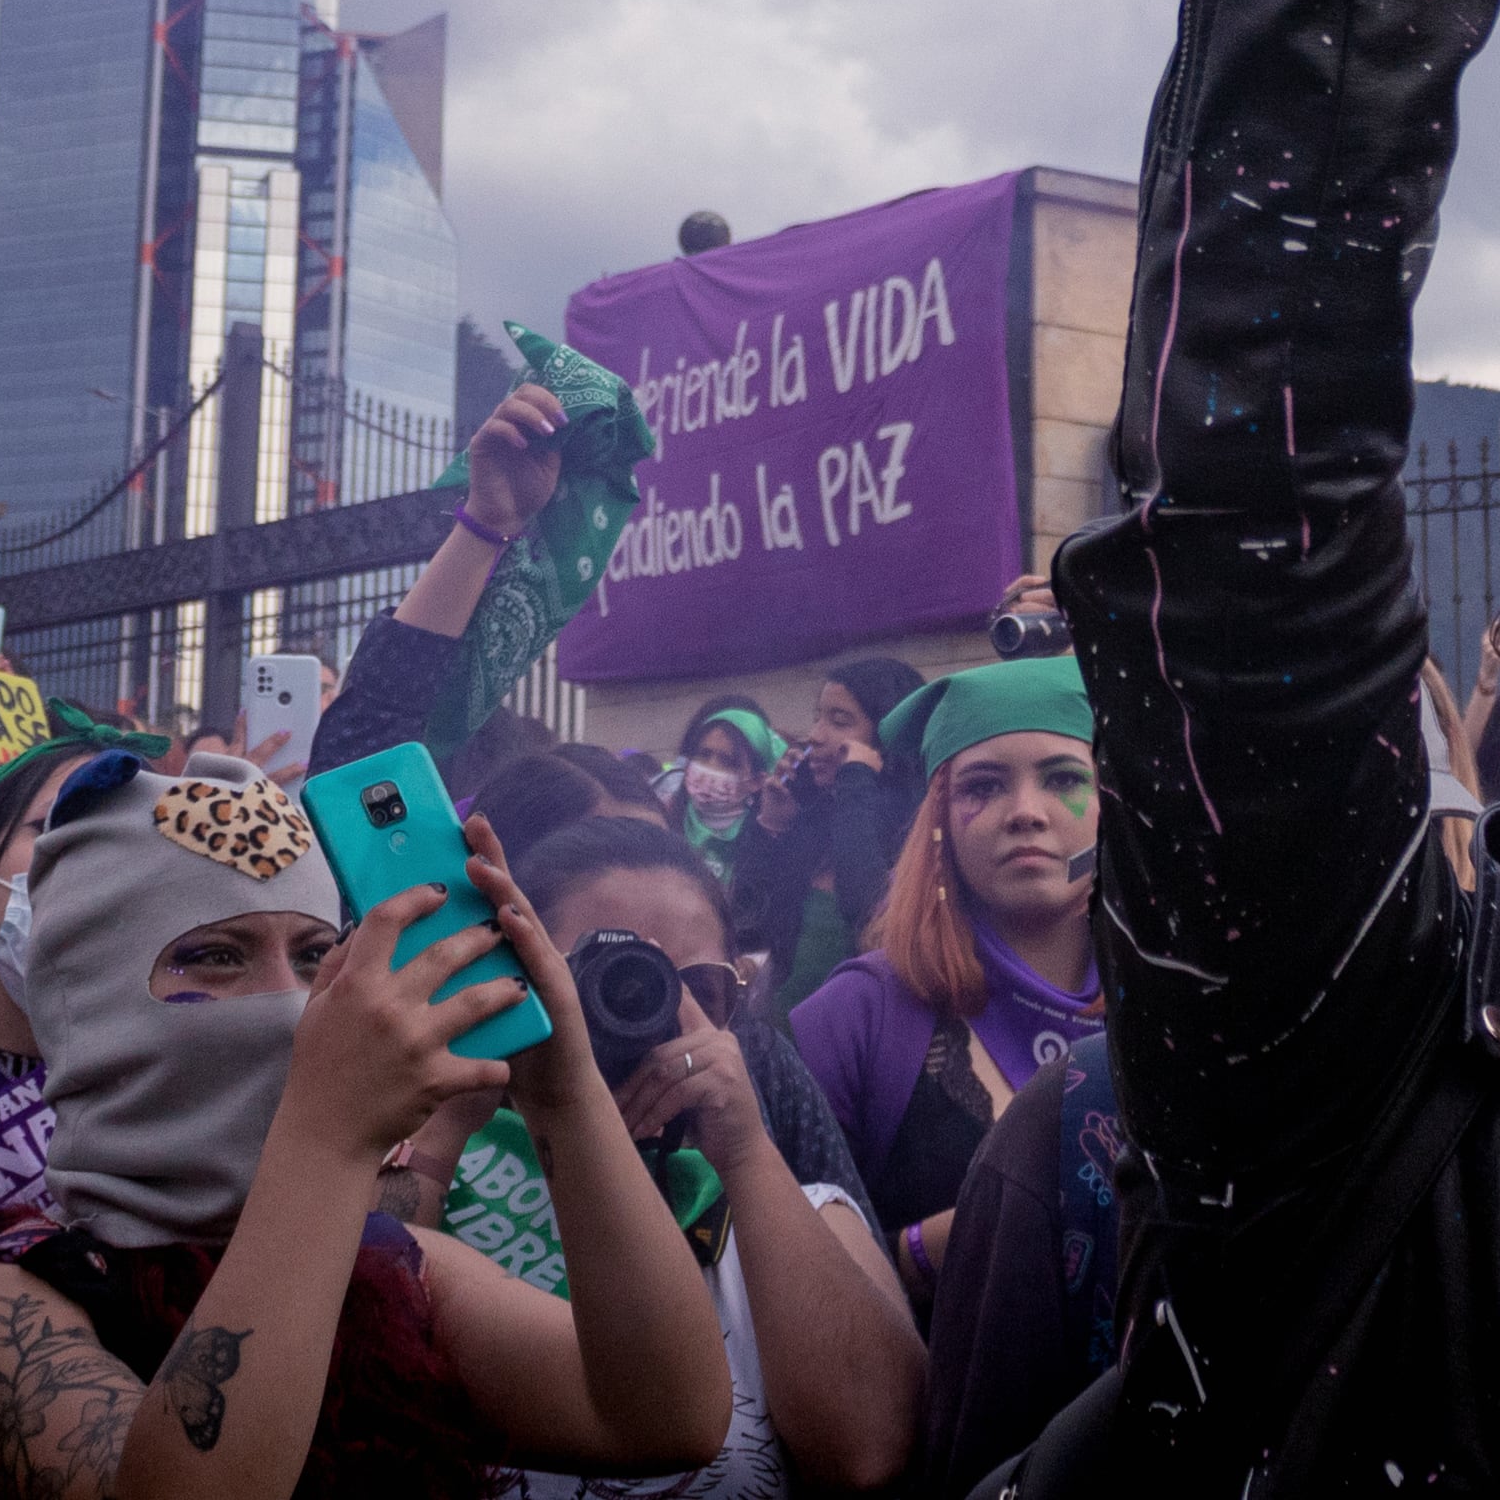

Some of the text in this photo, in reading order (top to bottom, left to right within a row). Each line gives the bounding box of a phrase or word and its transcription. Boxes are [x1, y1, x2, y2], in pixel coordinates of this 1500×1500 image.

[770, 314, 808, 408] la
[823, 257, 956, 394] VIDA
[756, 463, 805, 552] la
[817, 421, 915, 548] PAZ
[597, 931, 635, 943] Nikon
[445, 1180, 567, 1293] IBRE
